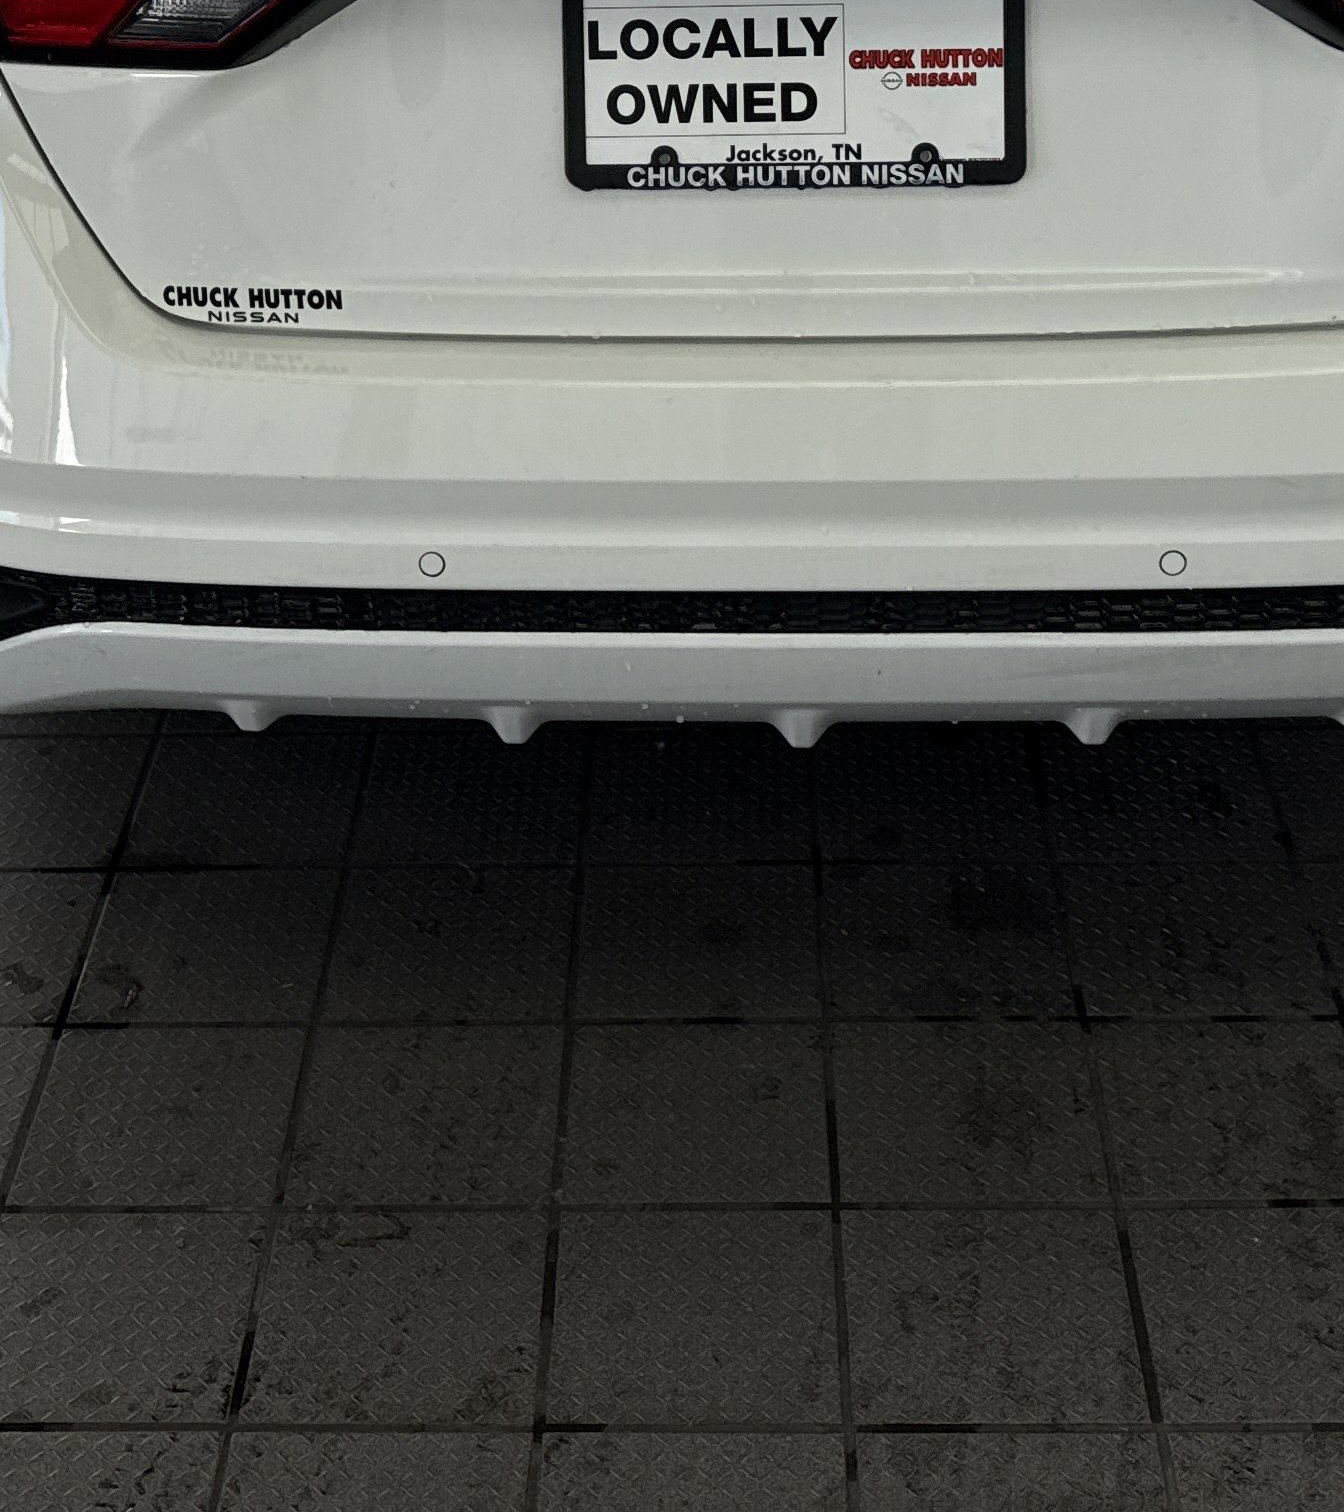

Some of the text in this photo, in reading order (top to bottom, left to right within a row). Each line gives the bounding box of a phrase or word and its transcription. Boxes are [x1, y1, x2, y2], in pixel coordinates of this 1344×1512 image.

[587, 15, 839, 61] LOCALLY
[848, 47, 1004, 70] CHUCK HUTTON
[905, 71, 978, 87] NISSAN
[606, 81, 819, 126] OWNED
[725, 143, 863, 164] Jackson, TN
[626, 163, 965, 188] CHUCK HUTTON NISSAN
[162, 285, 344, 310] CHUCK HUTTON
[207, 310, 299, 324] NISSAN
